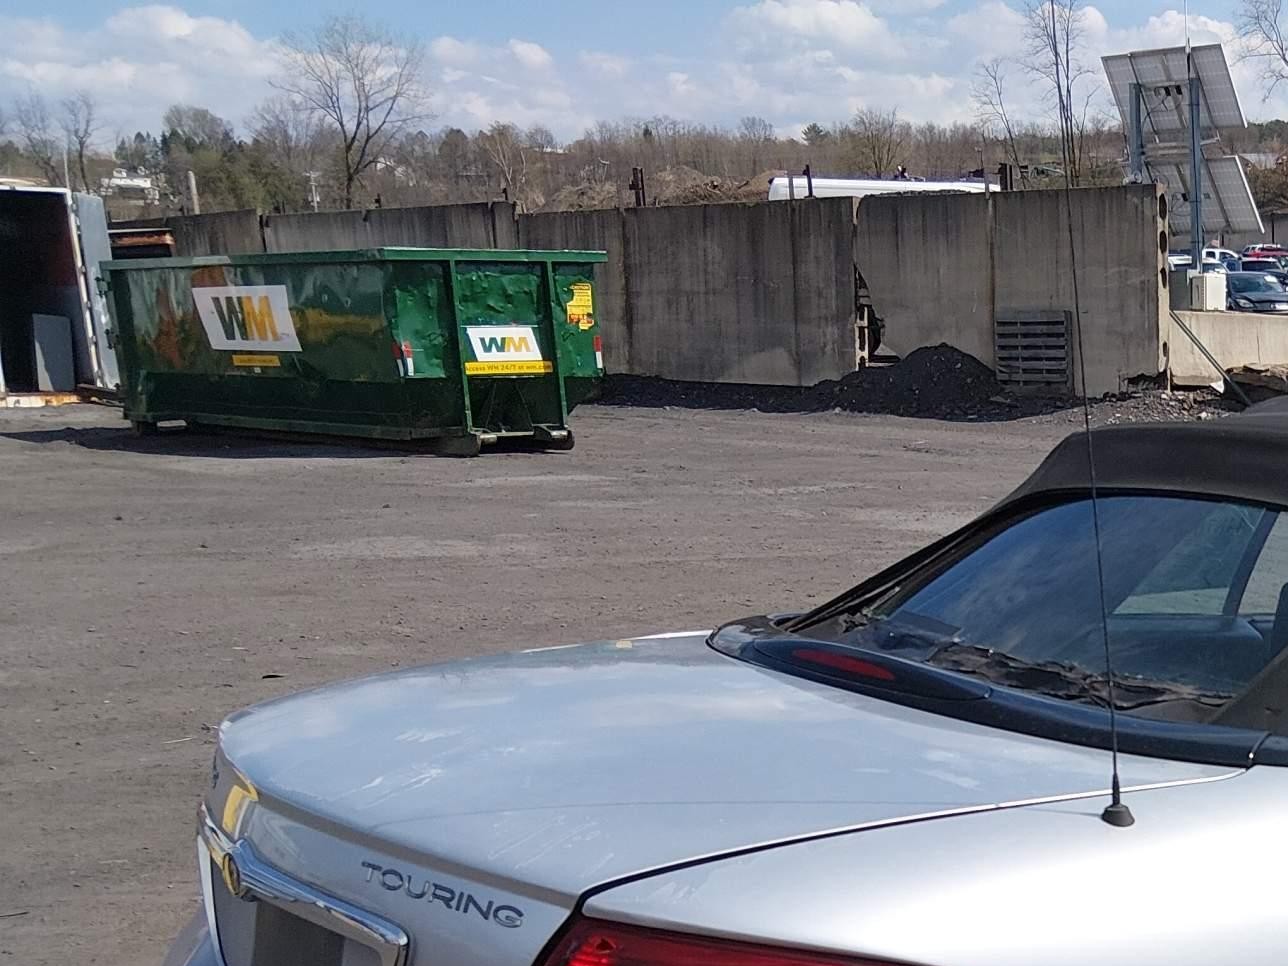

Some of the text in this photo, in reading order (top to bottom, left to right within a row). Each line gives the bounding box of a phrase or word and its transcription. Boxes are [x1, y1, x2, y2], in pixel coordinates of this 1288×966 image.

[210, 296, 281, 341] WM
[478, 336, 532, 353] WM
[361, 861, 524, 928] TOURING
